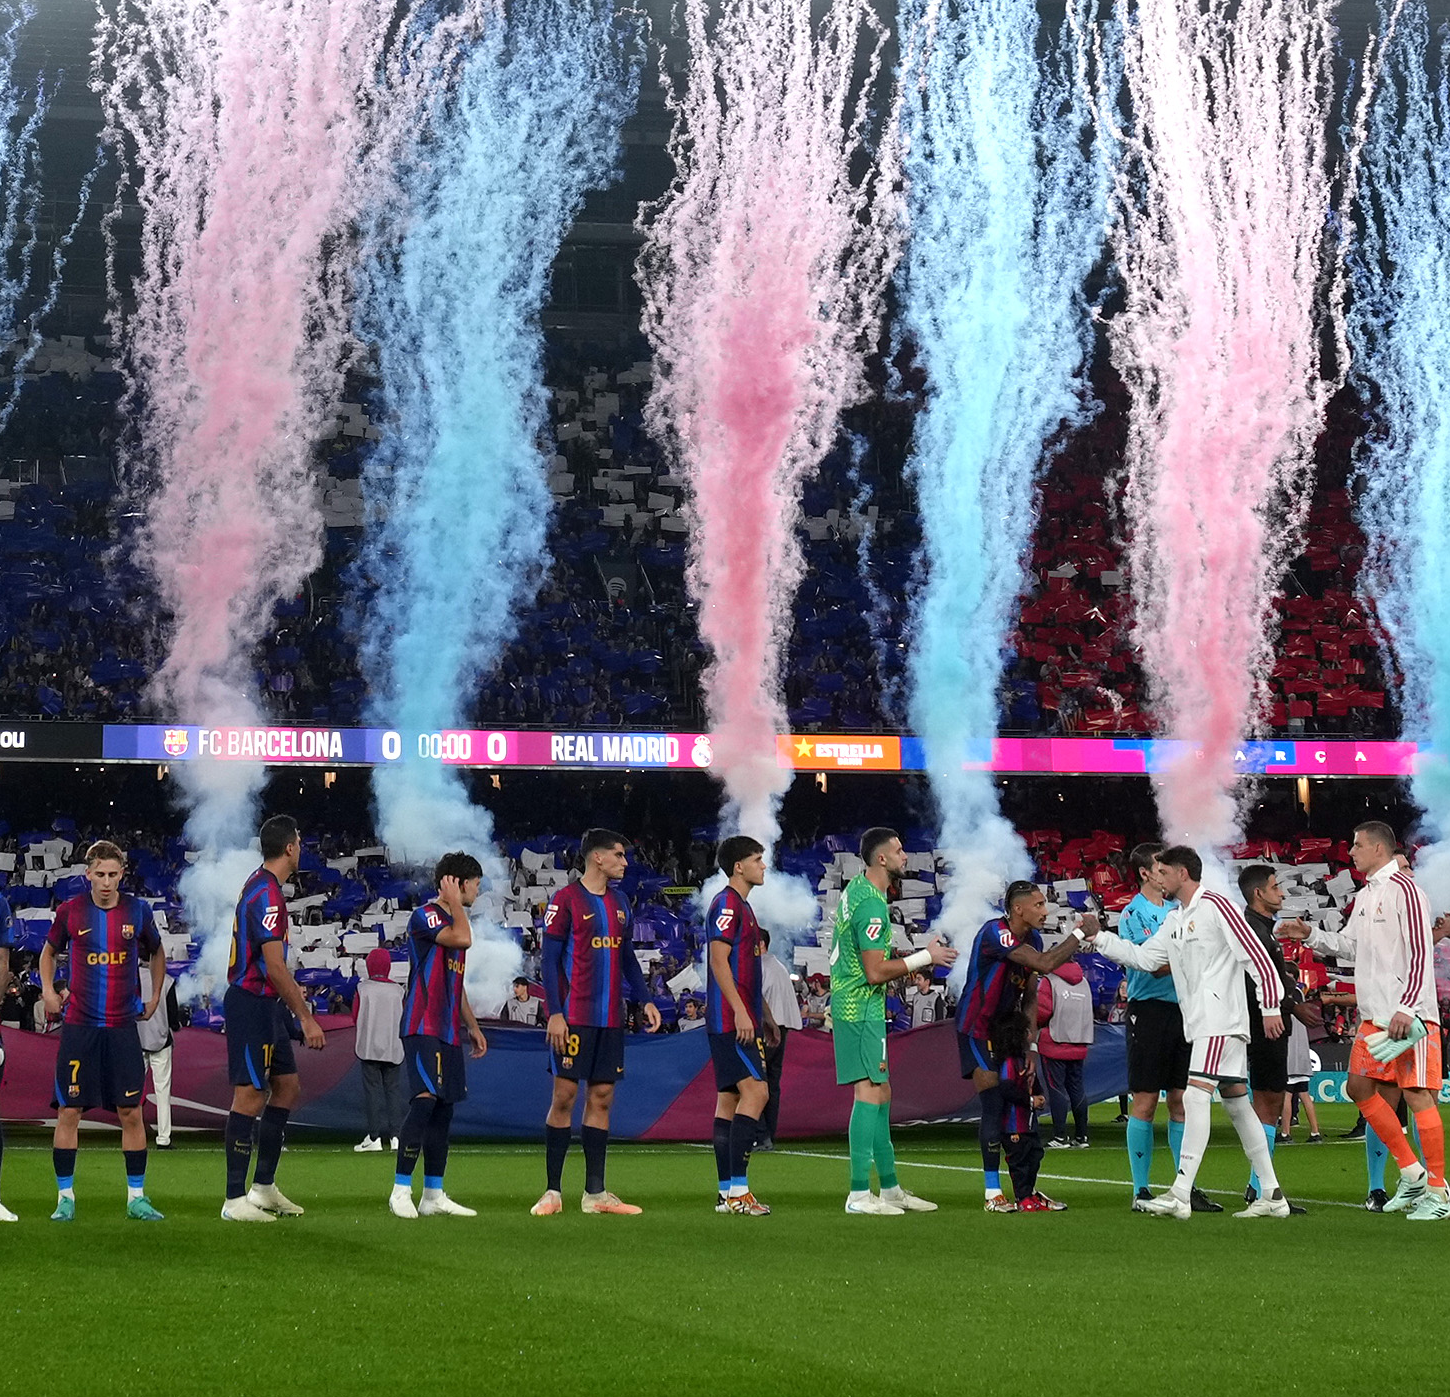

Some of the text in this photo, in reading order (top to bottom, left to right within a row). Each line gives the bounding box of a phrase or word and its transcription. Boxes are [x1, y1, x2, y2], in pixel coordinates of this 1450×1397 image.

[199, 729, 507, 762] FC BARCELONA 0 00:00 0
[551, 735, 679, 763] REAL MADRID
[815, 744, 884, 759] ESTRELLA
[591, 936, 622, 949] GOLF
[87, 951, 127, 965] GOLF
[69, 1060, 81, 1083] 7
